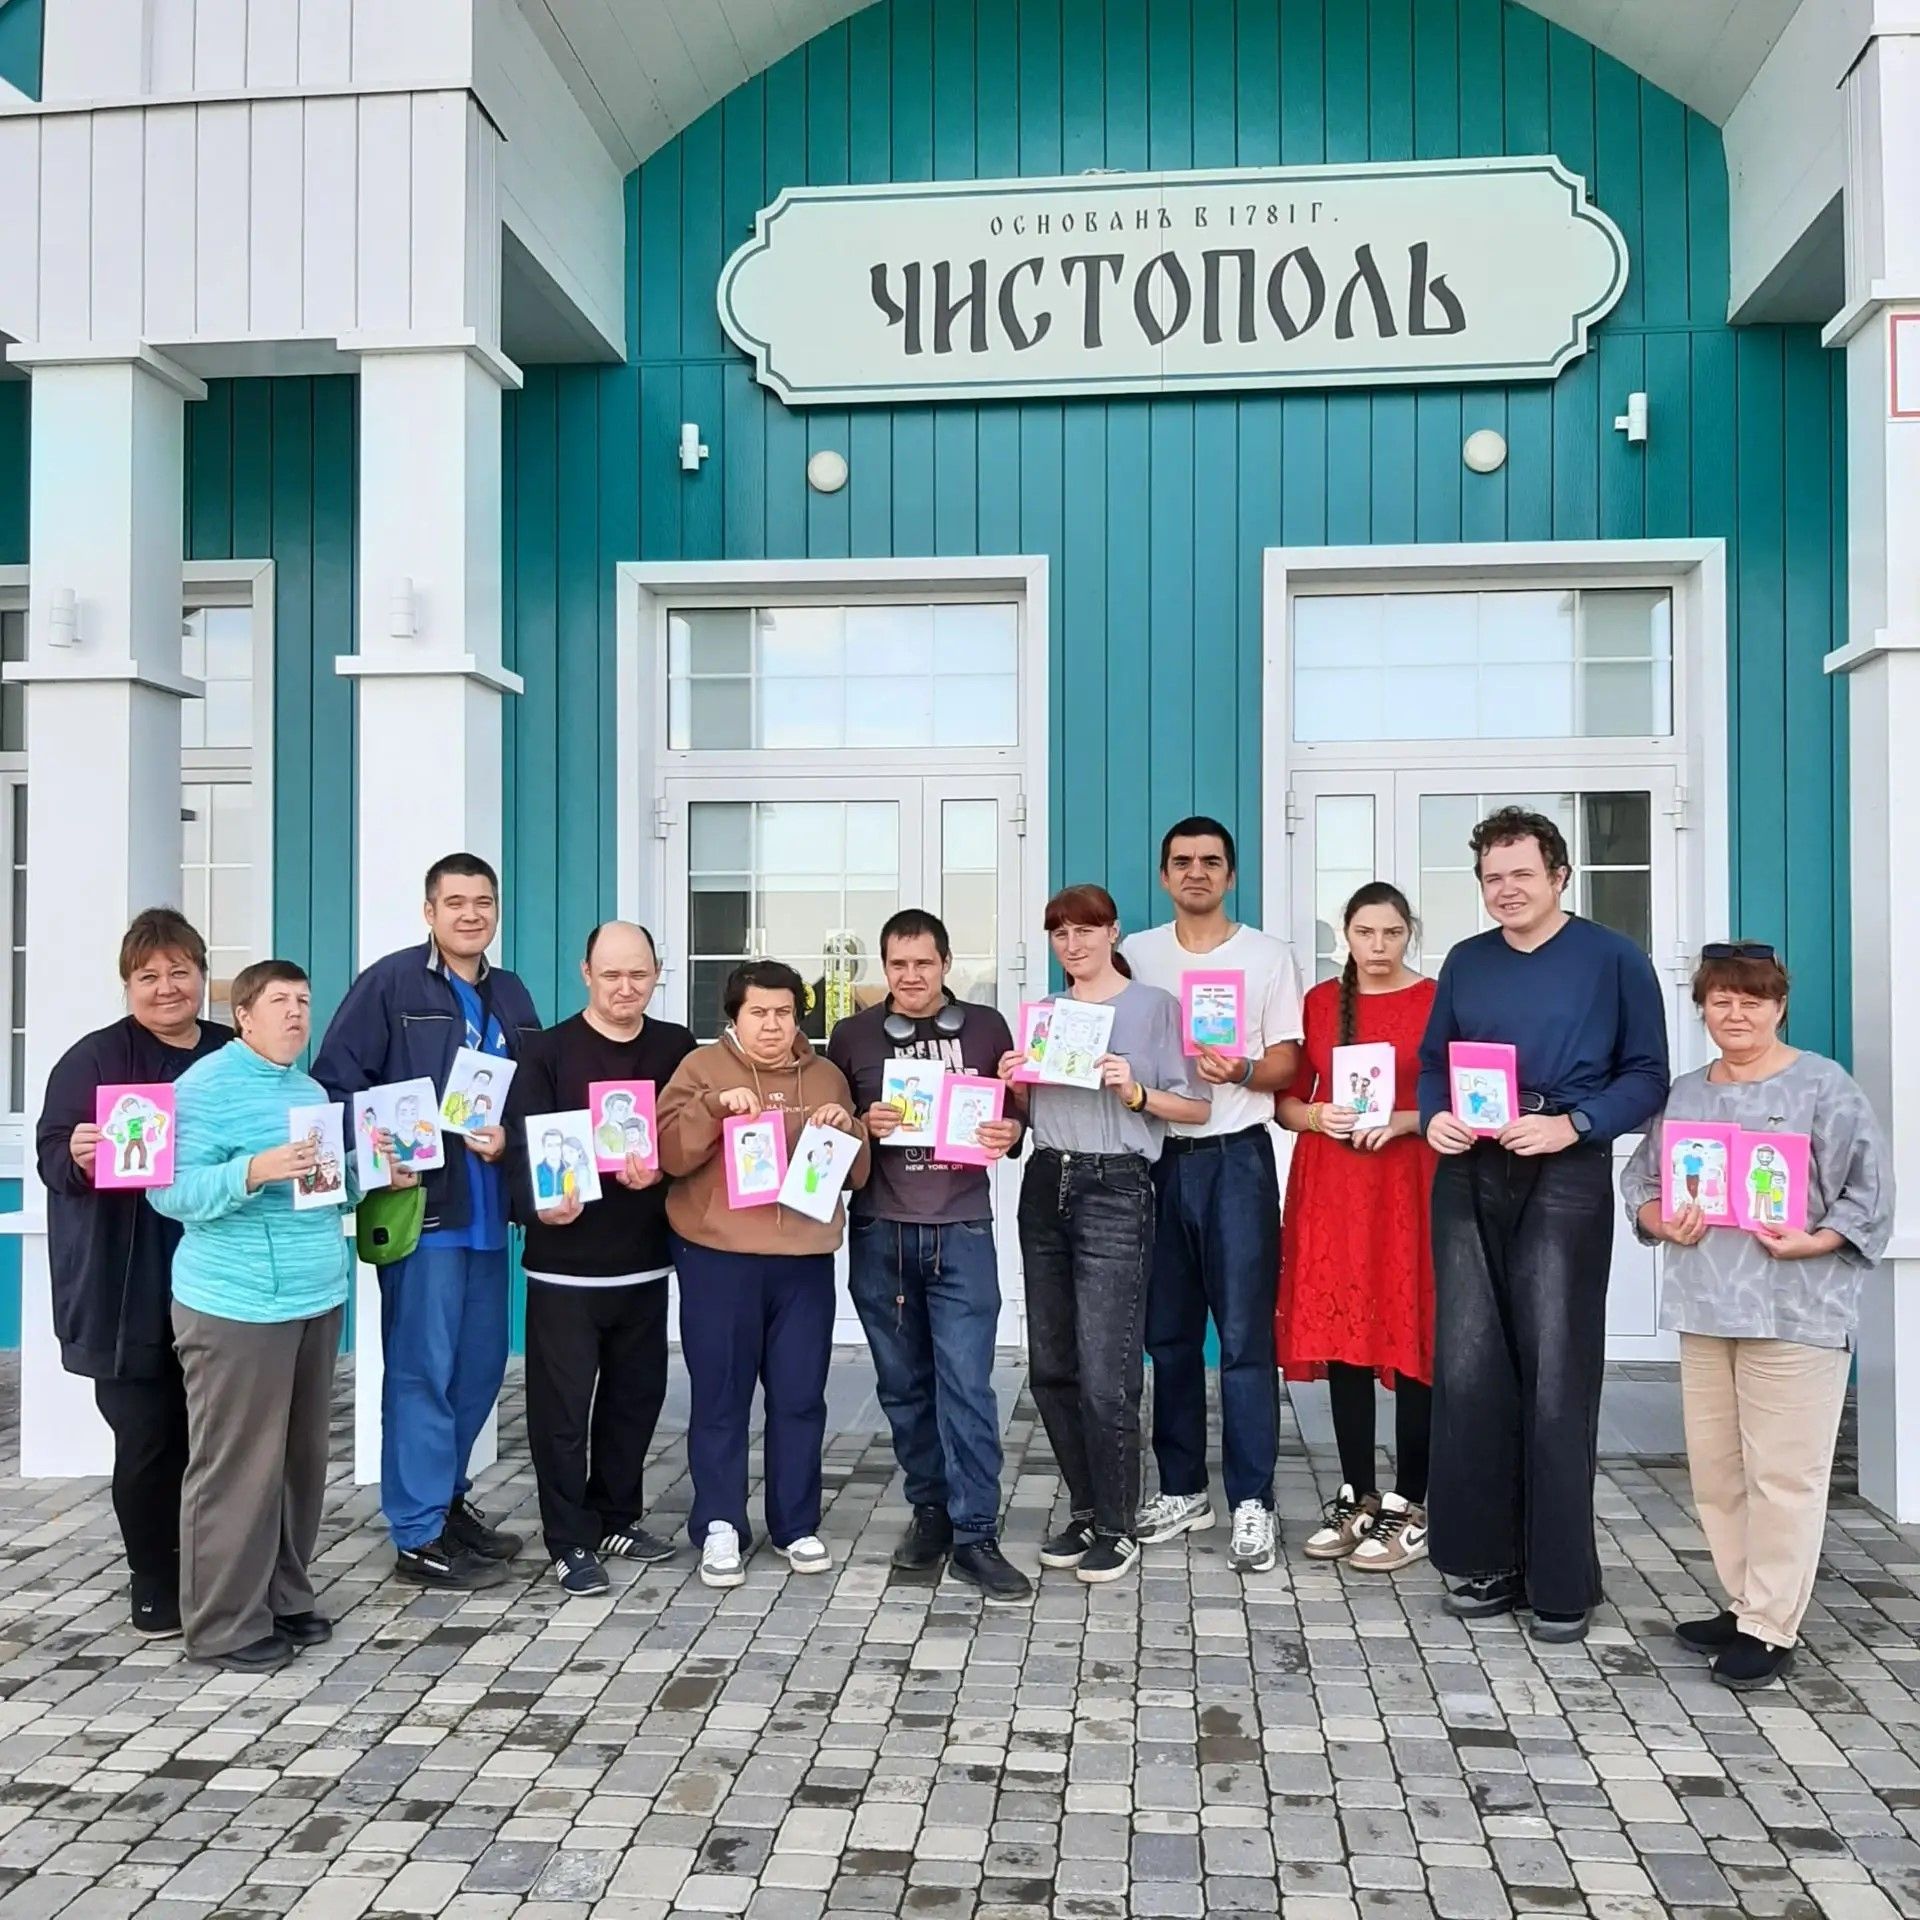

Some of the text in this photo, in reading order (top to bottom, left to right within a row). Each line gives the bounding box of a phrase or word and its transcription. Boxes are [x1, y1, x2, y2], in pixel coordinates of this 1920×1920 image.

[1194, 206, 1209, 228] В
[1229, 203, 1296, 227] 1781
[869, 241, 1468, 356] ЧИСТОПОЛЬ
